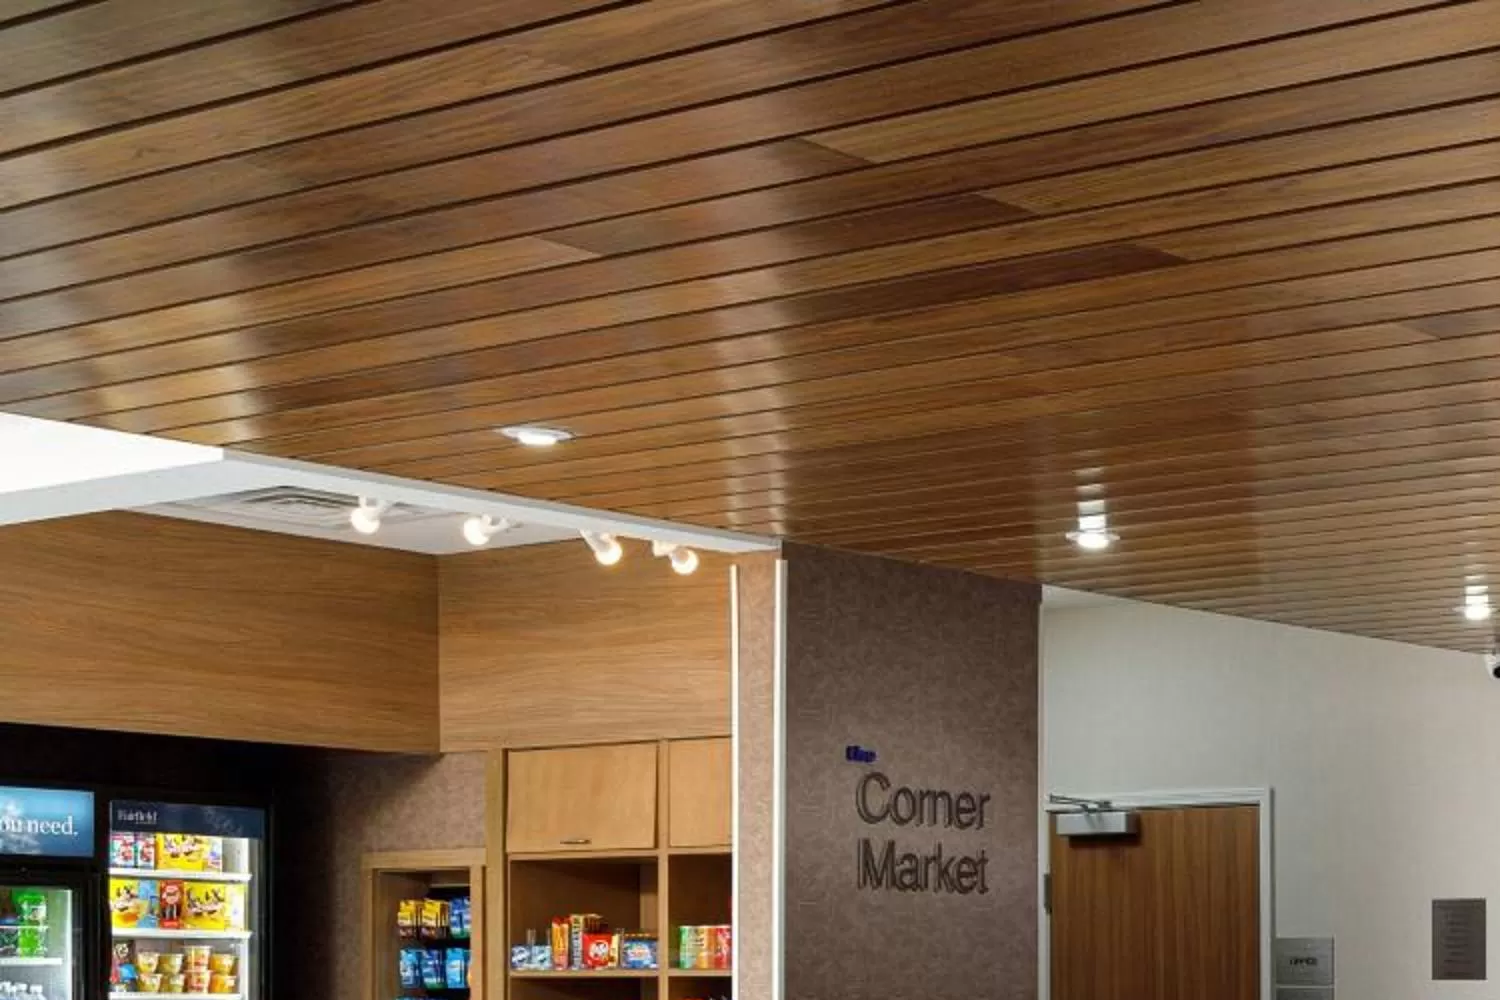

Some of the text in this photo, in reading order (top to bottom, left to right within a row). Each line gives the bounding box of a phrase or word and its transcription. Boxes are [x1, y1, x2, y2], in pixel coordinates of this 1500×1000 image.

[27, 815, 79, 836] need.
[855, 771, 991, 831] Corner
[857, 838, 989, 895] Market
